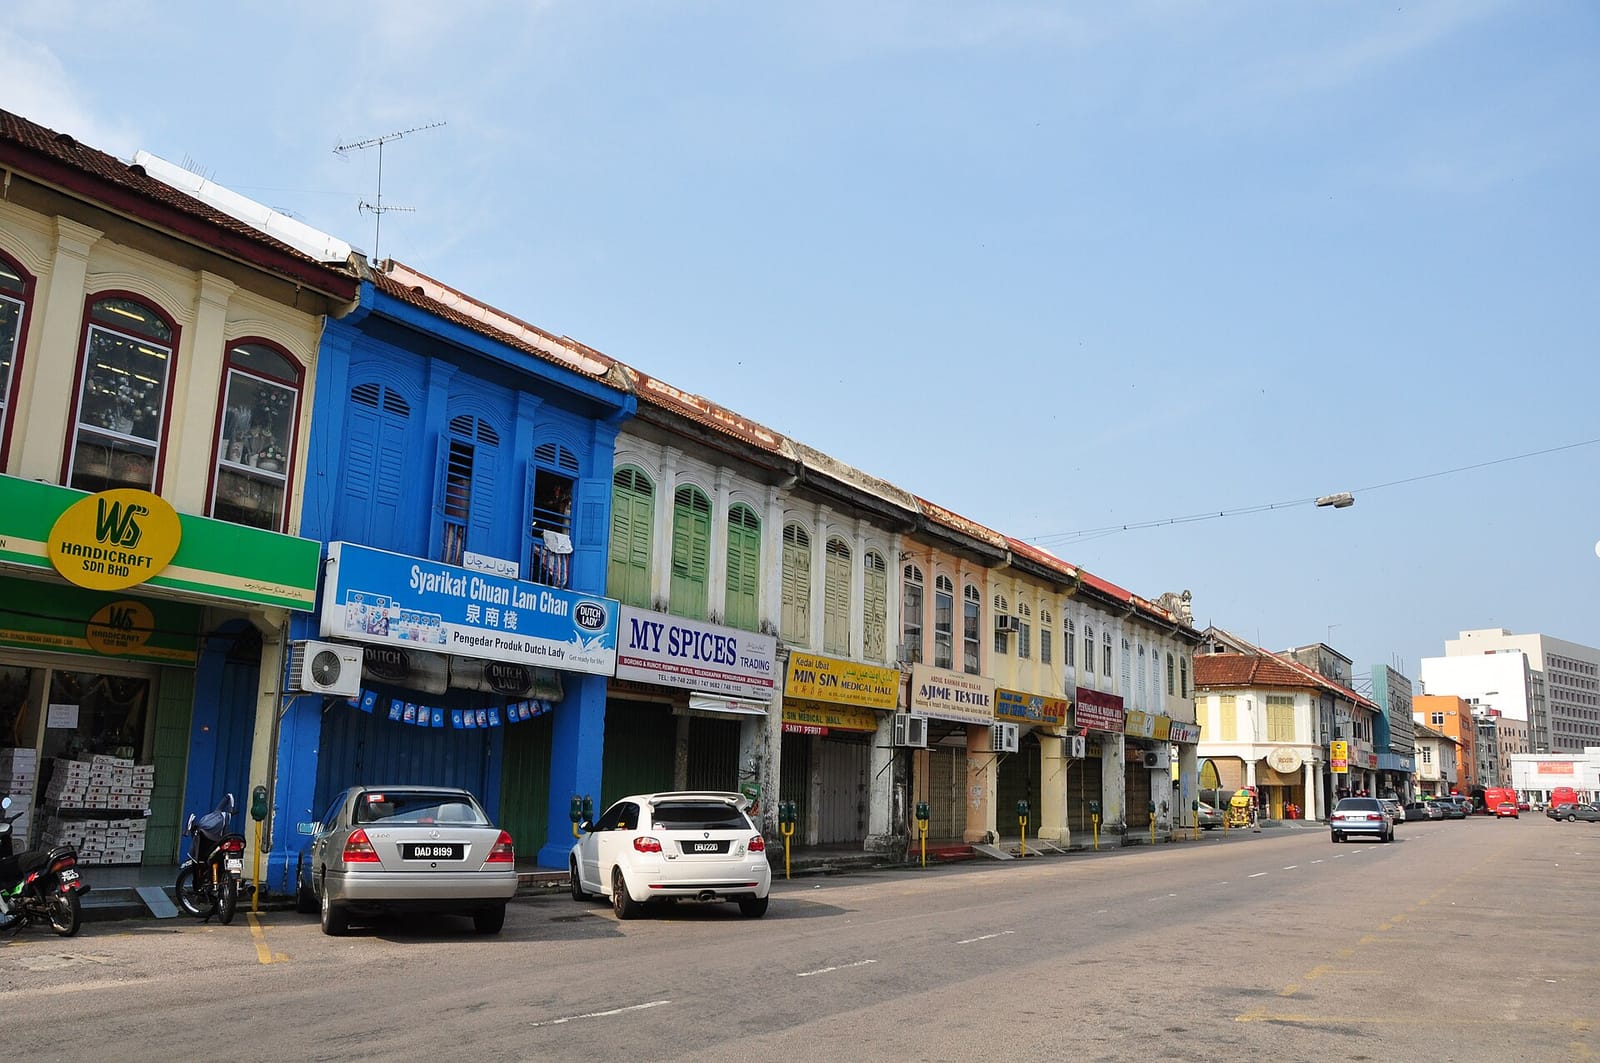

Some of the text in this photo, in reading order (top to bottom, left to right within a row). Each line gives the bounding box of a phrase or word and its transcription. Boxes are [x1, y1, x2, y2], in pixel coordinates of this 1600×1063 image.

[61, 542, 153, 568] HANDICRAFT
[82, 560, 129, 578] SDN BHD
[410, 564, 568, 617] Syarikat Chuan Lam Chan
[580, 606, 601, 620] DUTCH
[581, 615, 598, 627] LADY
[453, 631, 565, 661] Pengedar Produk Dutch Lady
[629, 618, 737, 666] MY SPICES
[365, 648, 401, 665] DUTCH
[740, 656, 770, 671] TRADING
[795, 656, 830, 671] Kedai Ubat
[658, 673, 669, 682] TEL:
[793, 669, 892, 696] MIN SIN MEDICAL HALL
[919, 684, 951, 700] AJIME
[955, 689, 990, 707] TEXTILE
[797, 713, 823, 724] MEDICAL
[414, 847, 453, 857] DAD 8199
